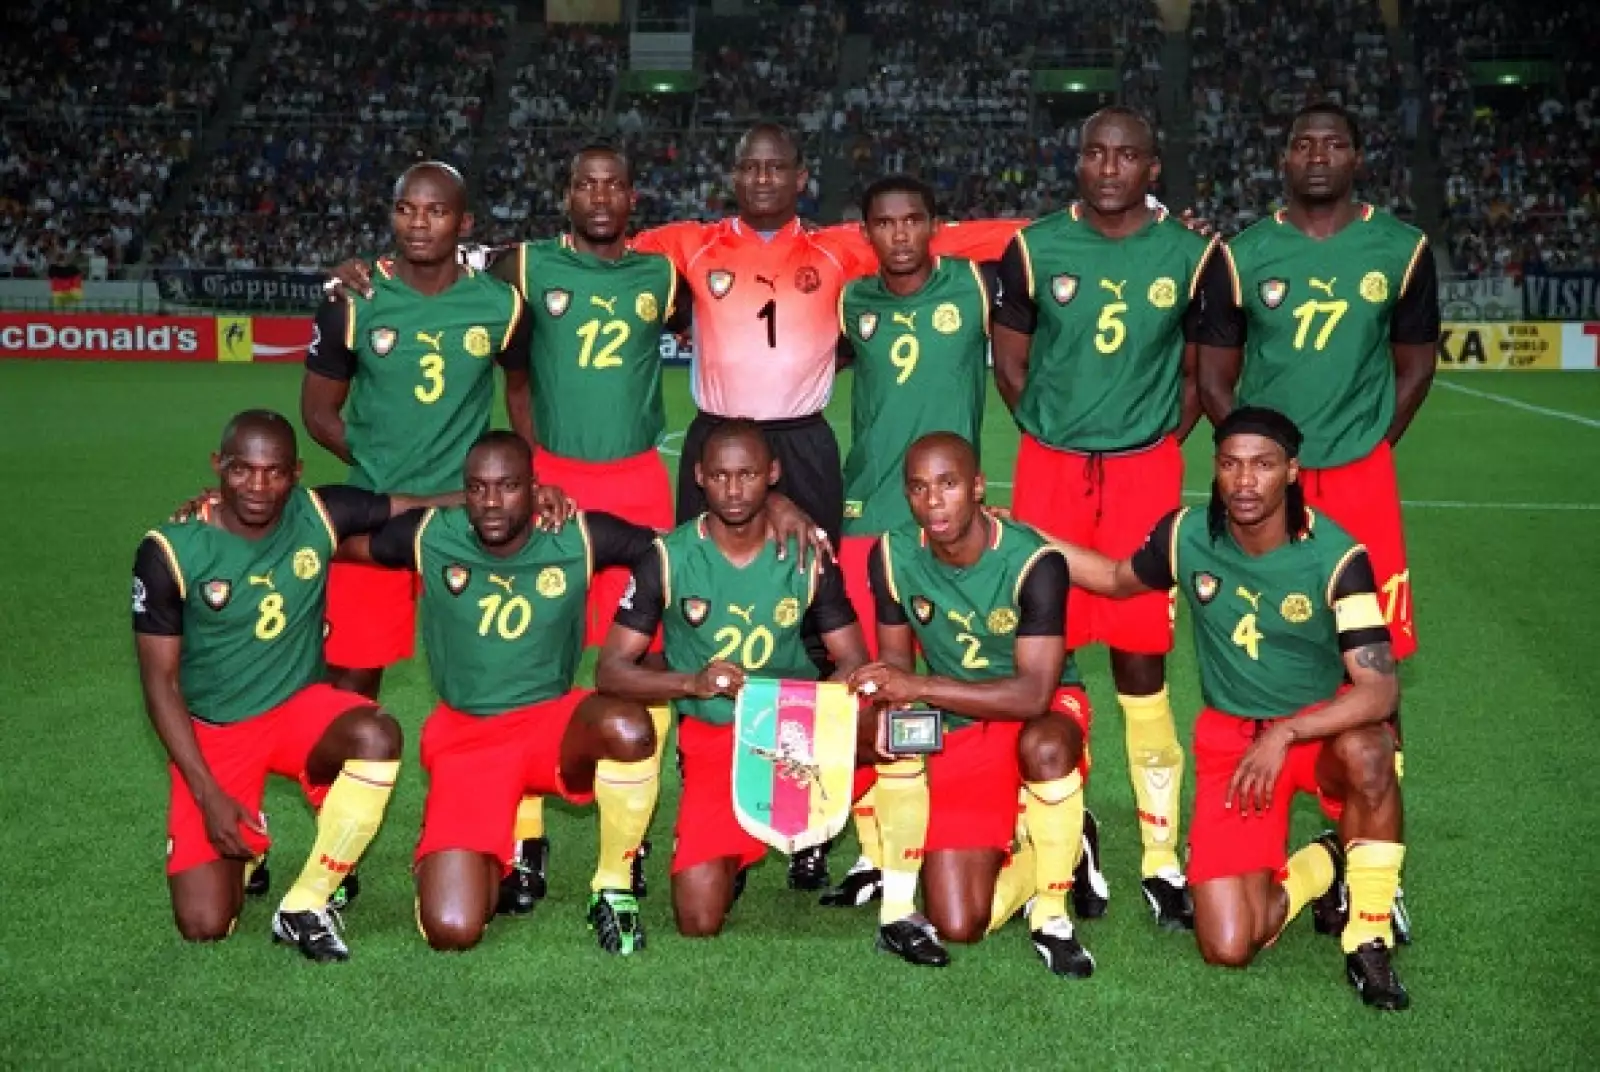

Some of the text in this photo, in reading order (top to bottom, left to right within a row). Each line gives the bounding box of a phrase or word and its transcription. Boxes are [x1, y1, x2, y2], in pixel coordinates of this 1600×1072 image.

[1526, 275, 1600, 317] VISI
[1, 323, 198, 351] cDonald's
[576, 319, 631, 369] 12
[757, 299, 777, 348] 1
[1094, 301, 1127, 354] 5
[1293, 299, 1348, 351] 17
[1499, 340, 1549, 351] WORLD
[414, 353, 445, 404] 3
[890, 333, 920, 384] 9
[255, 592, 287, 641] 8
[477, 593, 533, 640] 10
[1231, 612, 1264, 661] 4
[708, 624, 775, 670] 20
[956, 632, 990, 669] 2
